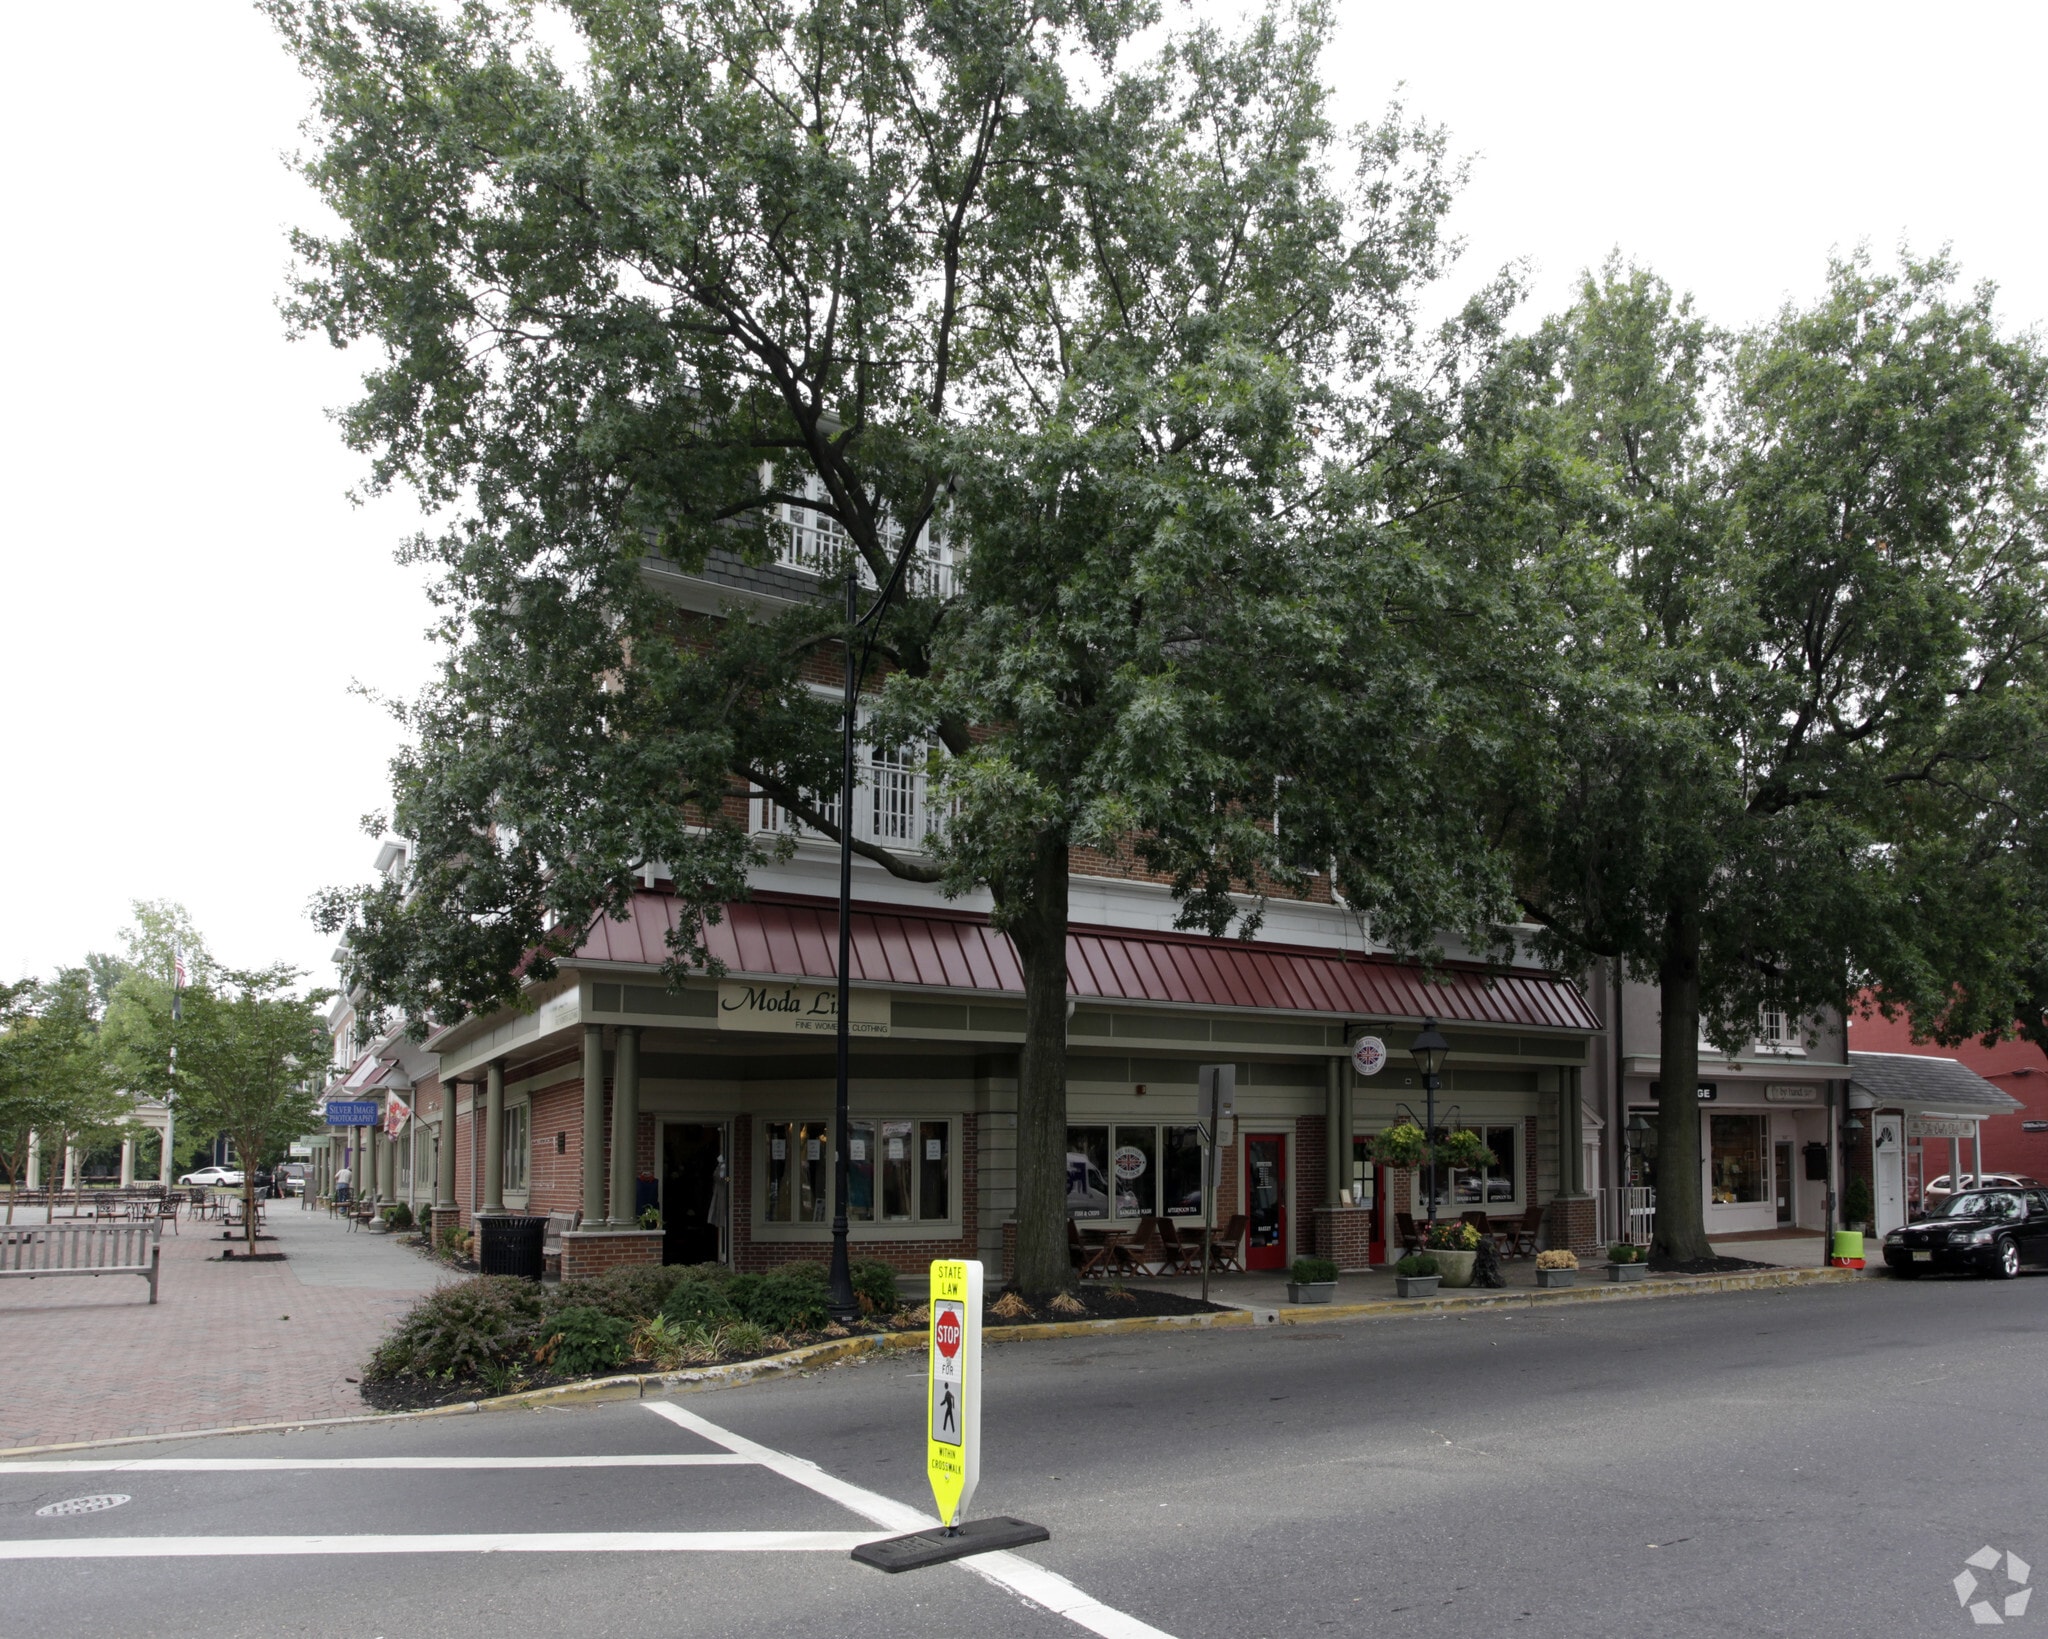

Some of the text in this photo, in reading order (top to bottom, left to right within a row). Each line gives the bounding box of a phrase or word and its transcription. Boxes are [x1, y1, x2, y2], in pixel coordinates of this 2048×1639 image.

[721, 986, 840, 1015] Moda Li
[796, 1021, 812, 1030] FINE
[852, 1024, 888, 1033] CLOTHING
[1697, 1088, 1711, 1098] GE
[329, 1104, 375, 1114] SILVER IMAGE
[329, 1114, 375, 1122] PHOTOGRAPHY
[938, 1266, 962, 1280] STATE
[941, 1282, 958, 1296] LAW
[937, 1324, 960, 1344] STOP
[941, 1364, 954, 1376] FOR
[938, 1447, 956, 1459] WITHIN
[931, 1458, 962, 1476] CROSSWALK
